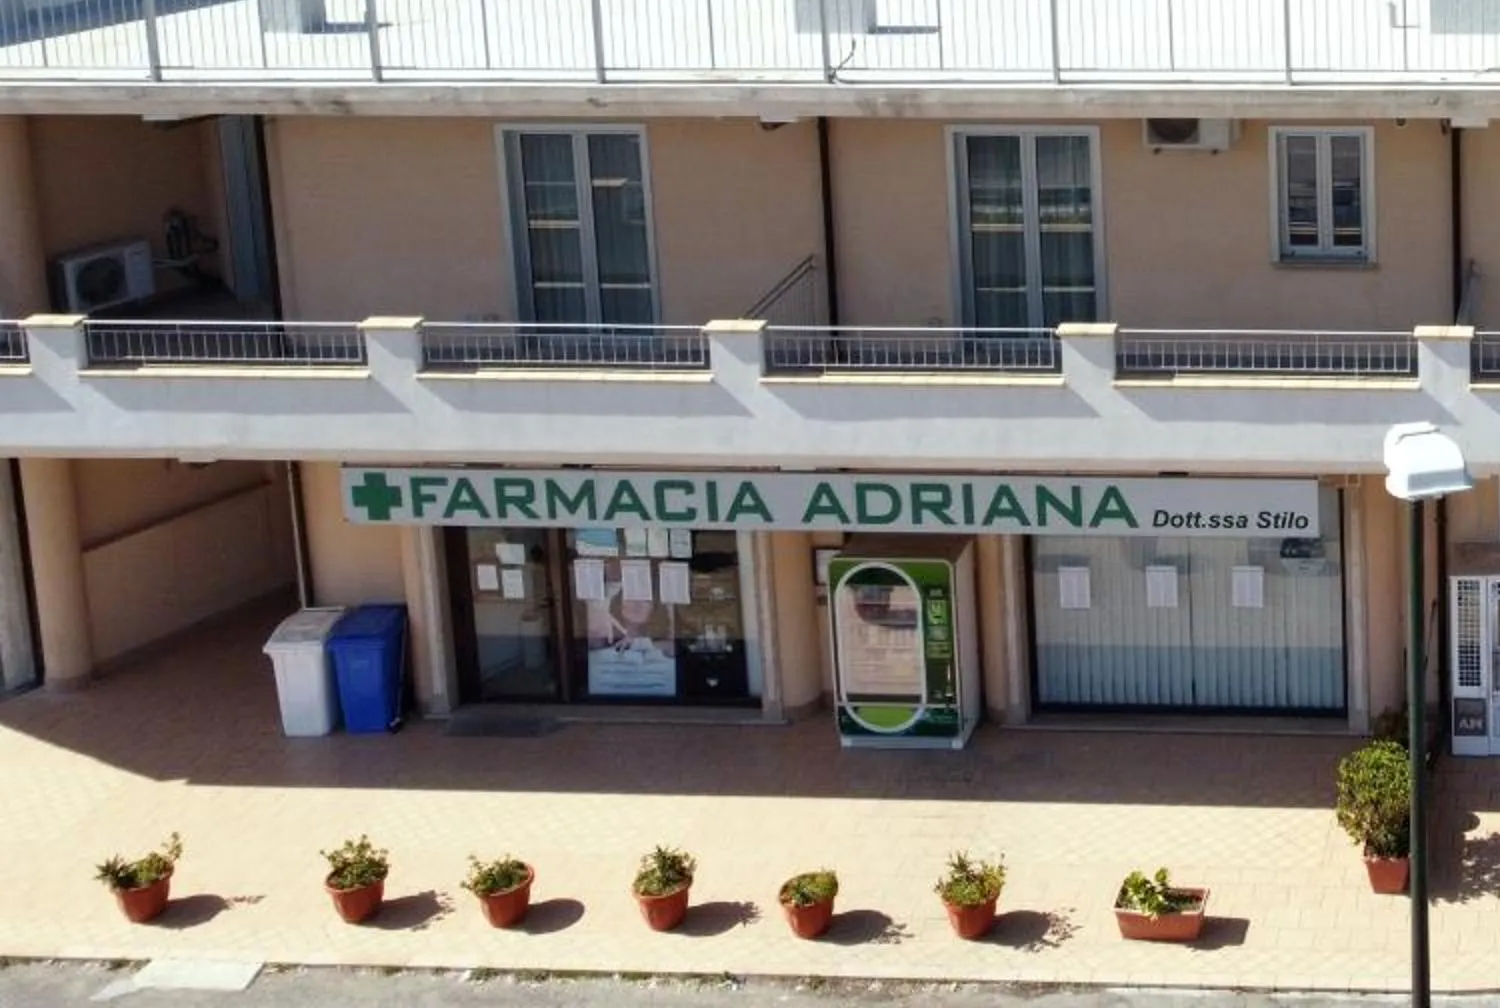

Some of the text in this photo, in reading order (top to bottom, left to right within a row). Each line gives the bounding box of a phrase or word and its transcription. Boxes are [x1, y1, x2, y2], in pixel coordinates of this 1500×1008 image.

[409, 476, 1140, 529] FARMACIA ADRIANA
[1152, 509, 1309, 530] Dott.ssa Stilo
